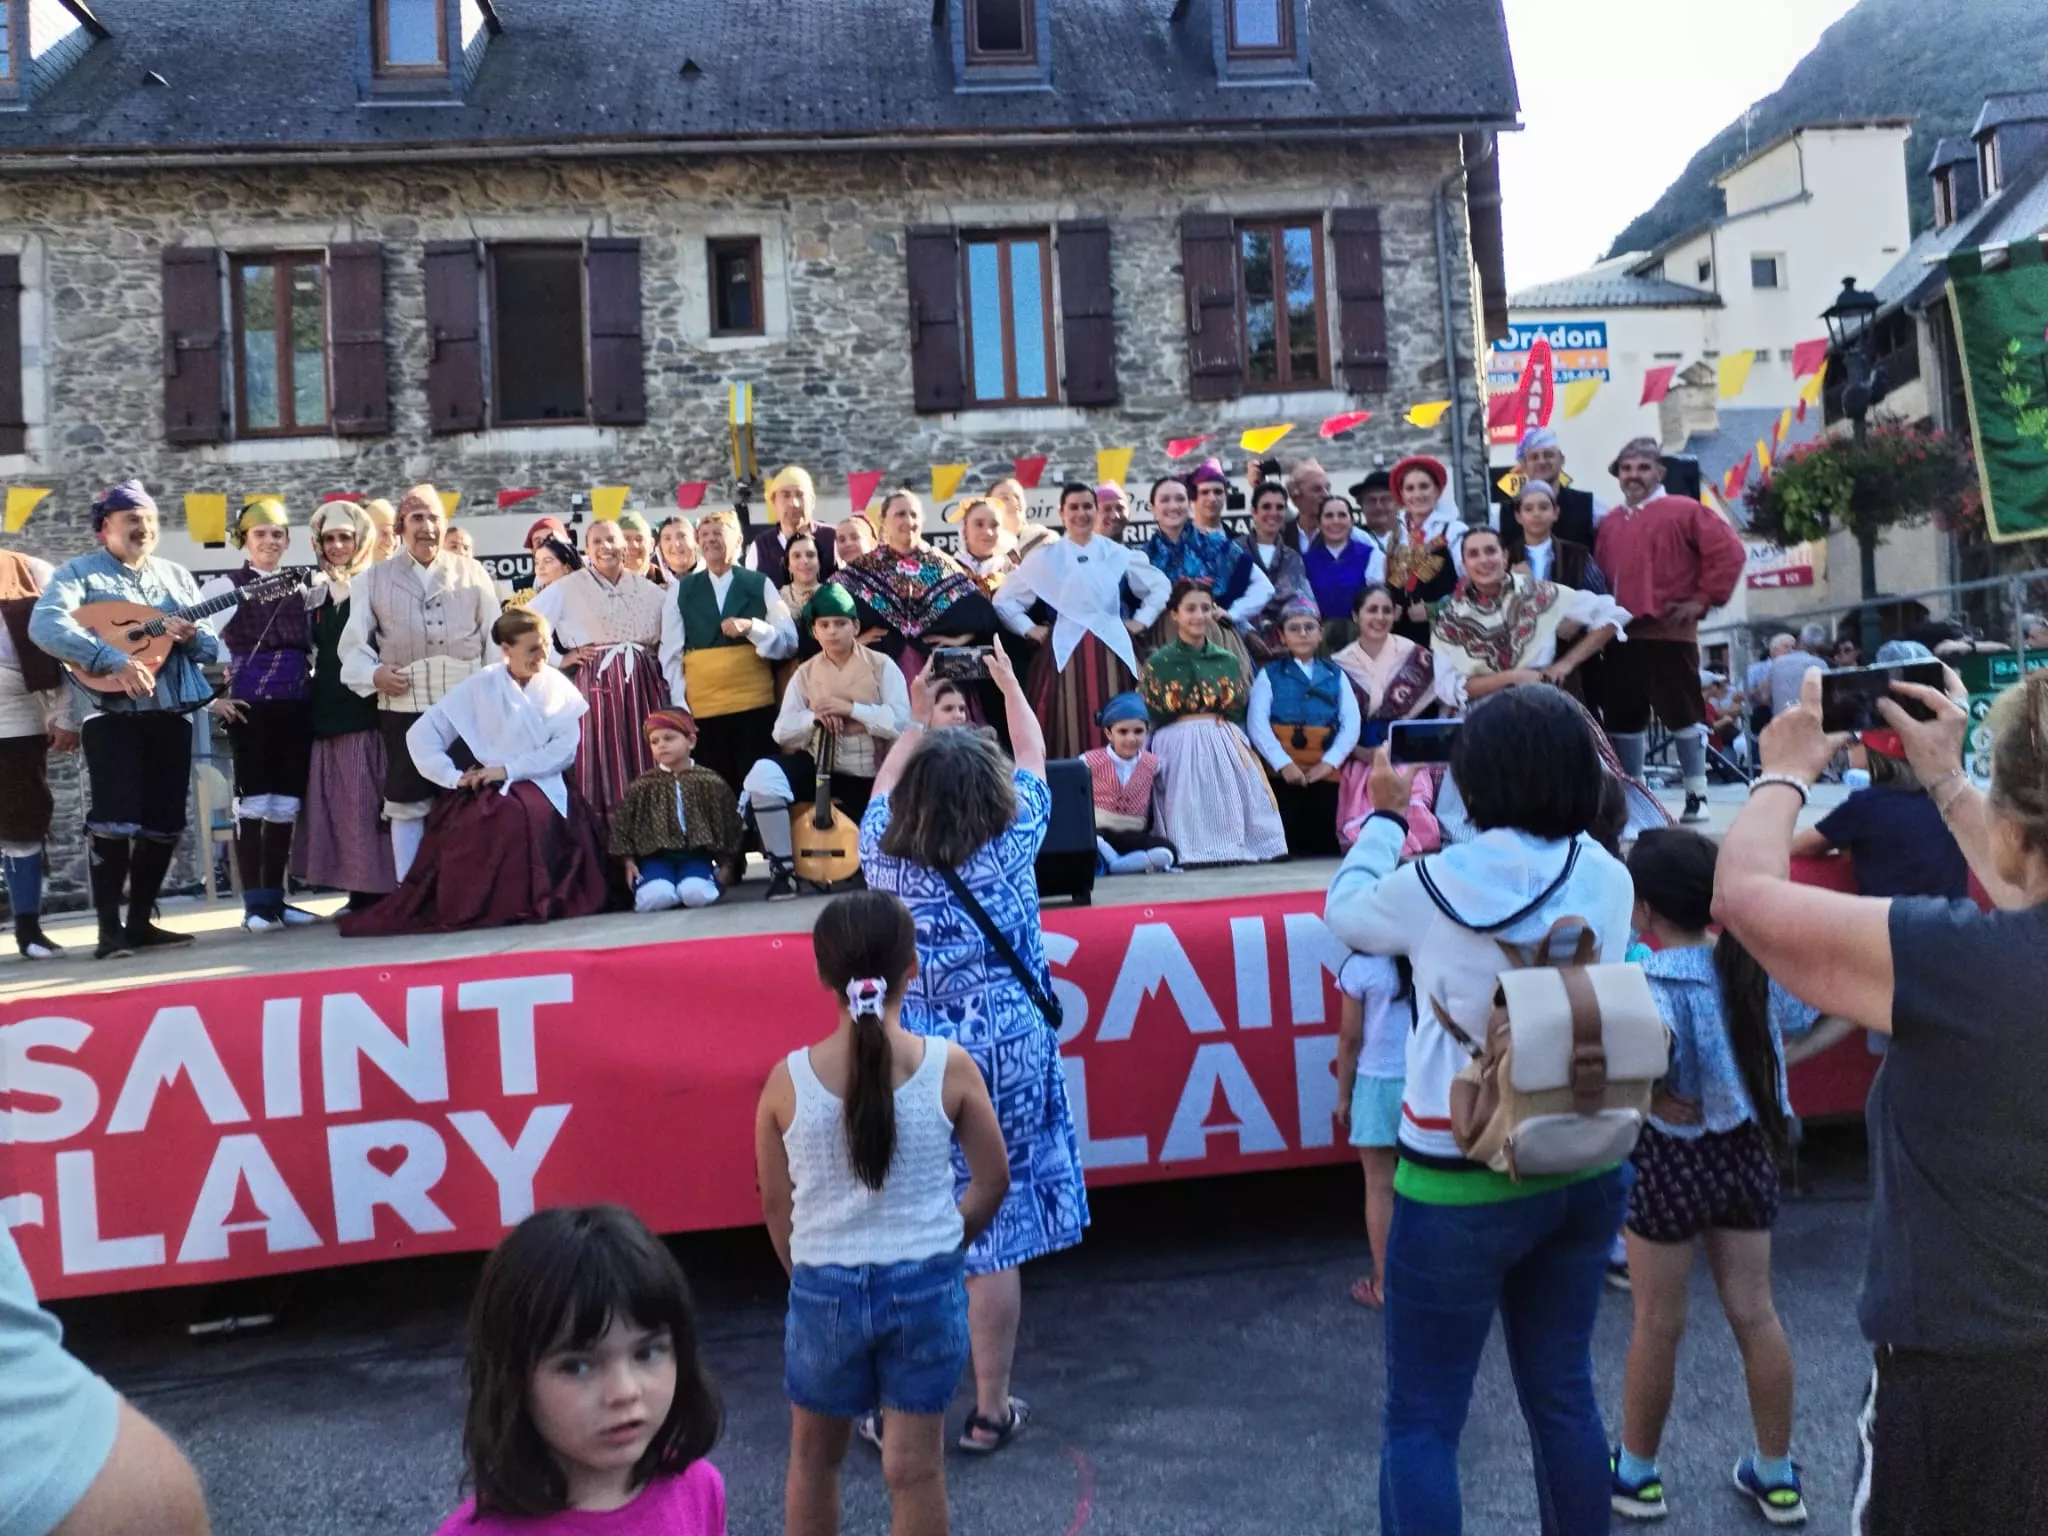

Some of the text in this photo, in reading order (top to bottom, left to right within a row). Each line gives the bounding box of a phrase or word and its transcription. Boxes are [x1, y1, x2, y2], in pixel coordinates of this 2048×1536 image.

[1525, 363, 1545, 425] TABA
[1041, 912, 1352, 1048] SAIN
[0, 973, 574, 1146] SAINT
[1059, 1034, 1340, 1170] LA
